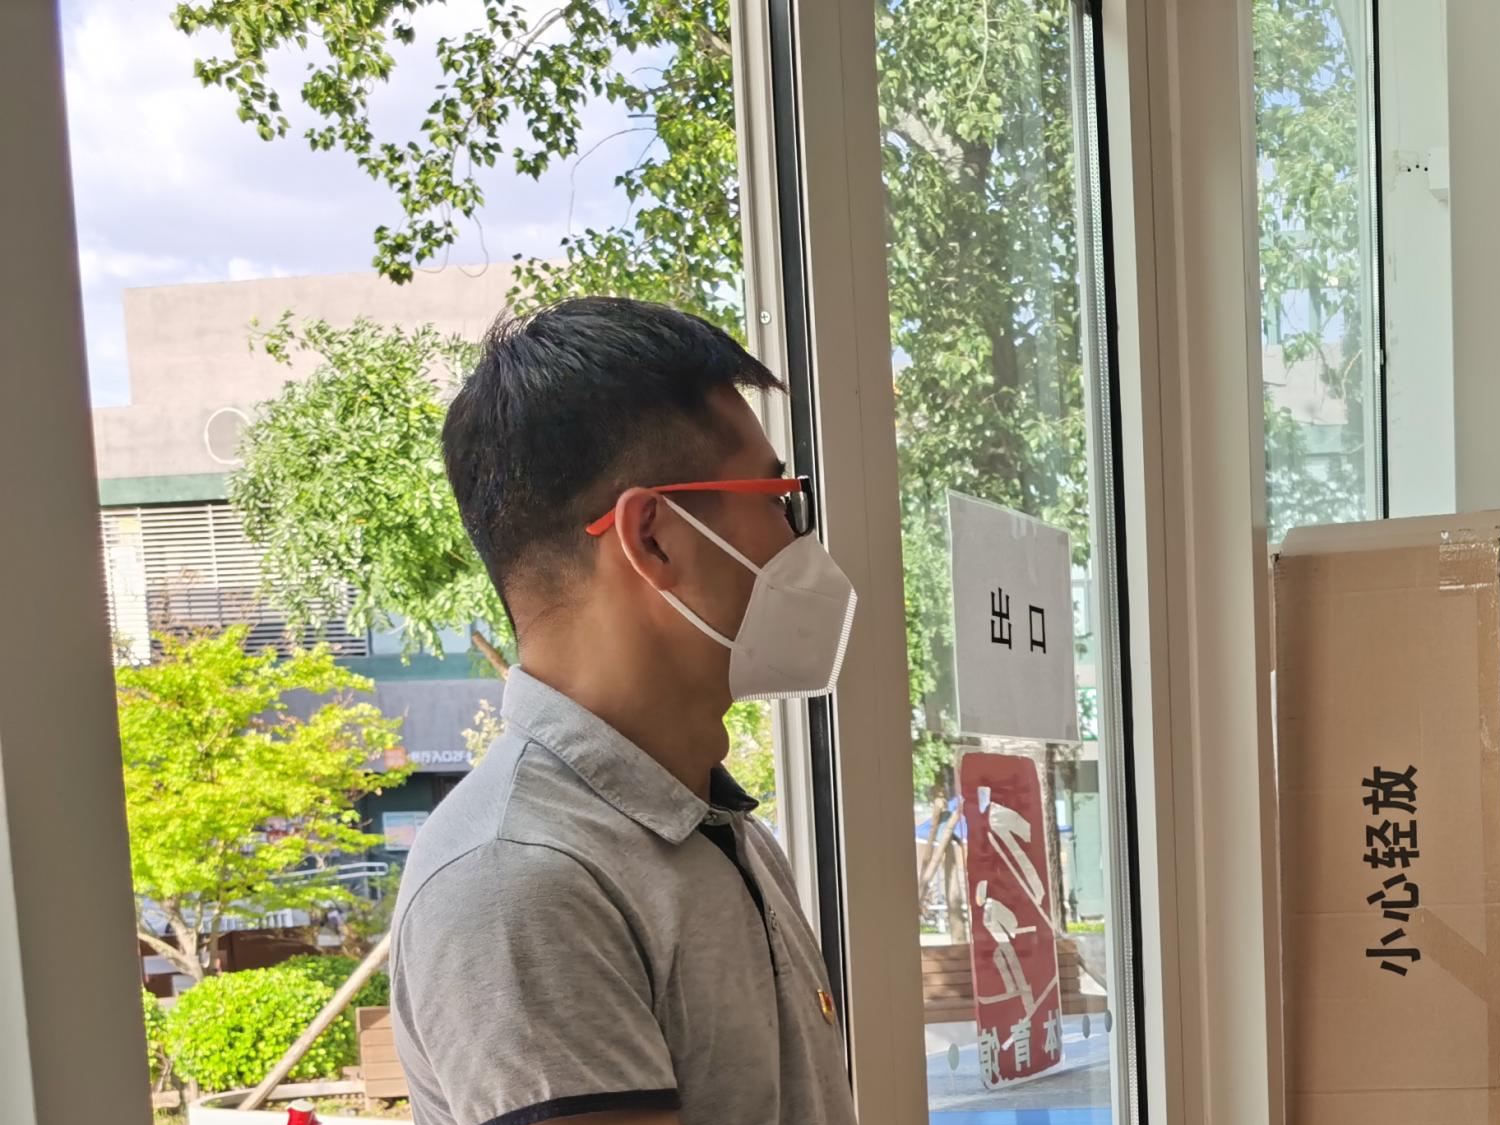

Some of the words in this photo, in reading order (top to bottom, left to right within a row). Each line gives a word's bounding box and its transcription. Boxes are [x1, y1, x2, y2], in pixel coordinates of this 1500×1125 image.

[990, 586, 1046, 654] 出口
[1362, 764, 1421, 977] 小心轻放
